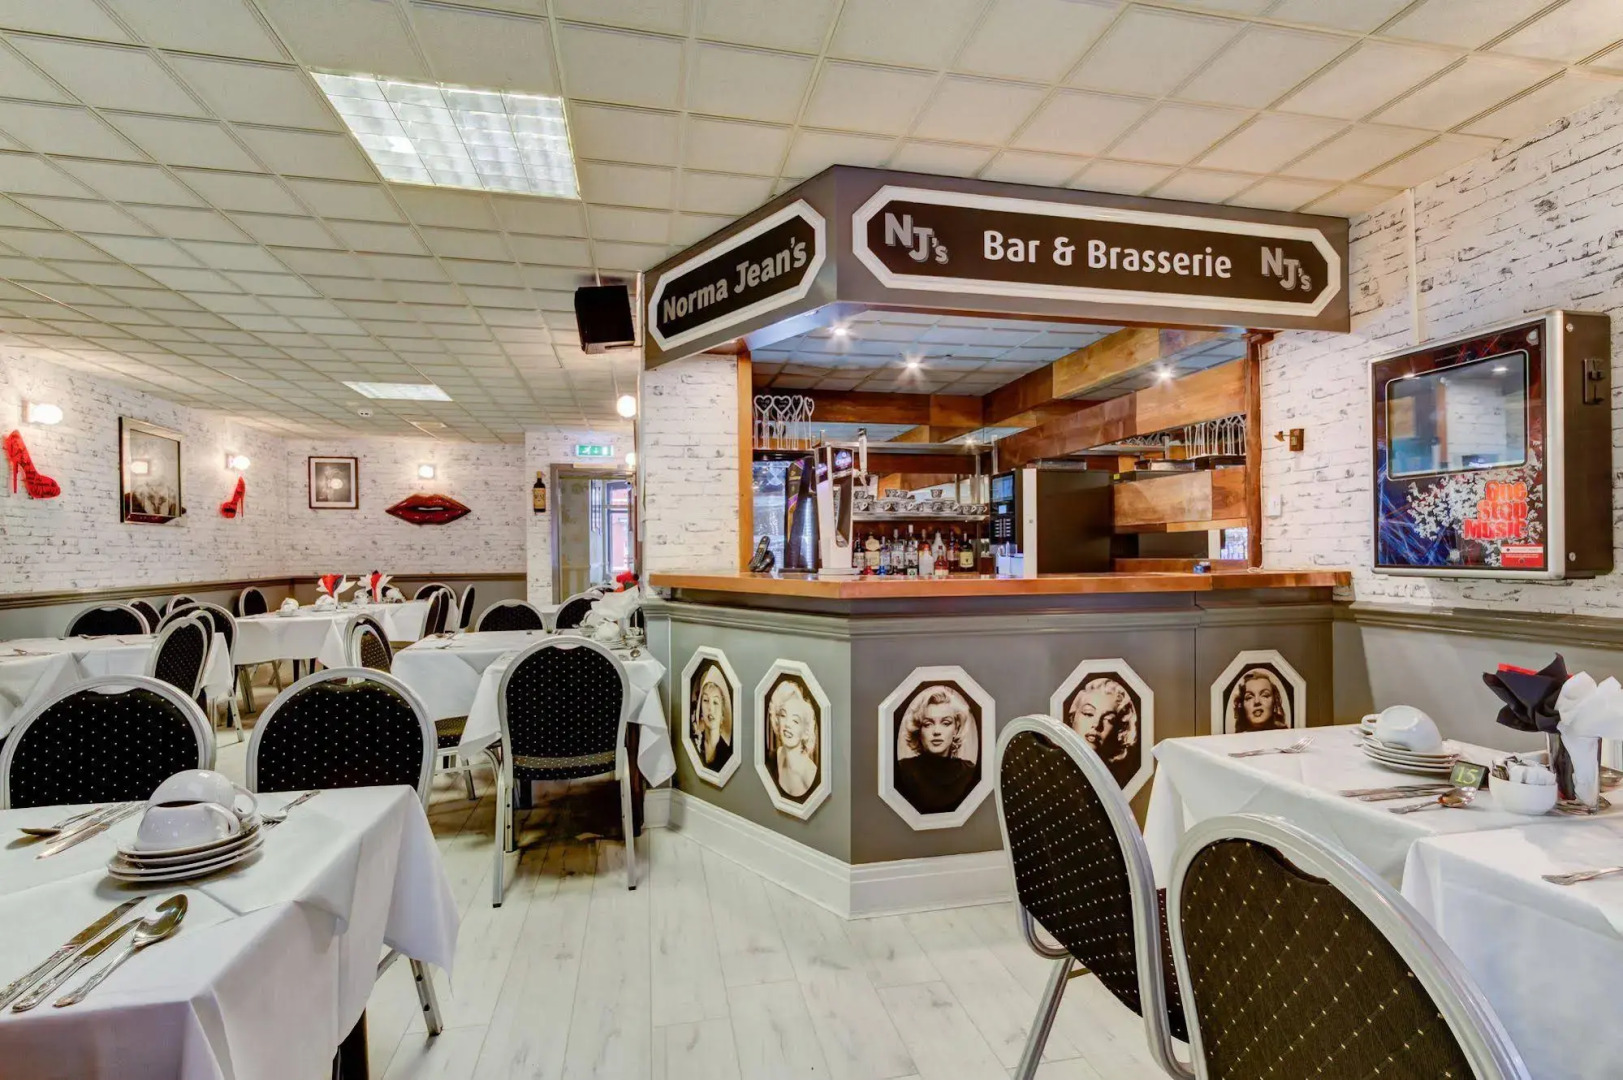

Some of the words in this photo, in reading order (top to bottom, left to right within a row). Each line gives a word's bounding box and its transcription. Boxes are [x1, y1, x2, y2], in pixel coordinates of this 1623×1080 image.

[983, 230, 1040, 263] Bar
[1052, 236, 1075, 266] &
[1087, 239, 1232, 278] Brasserie
[663, 278, 728, 323] Norma
[734, 237, 807, 294] Jean's
[1485, 481, 1527, 500] One
[1455, 766, 1478, 784] 15
